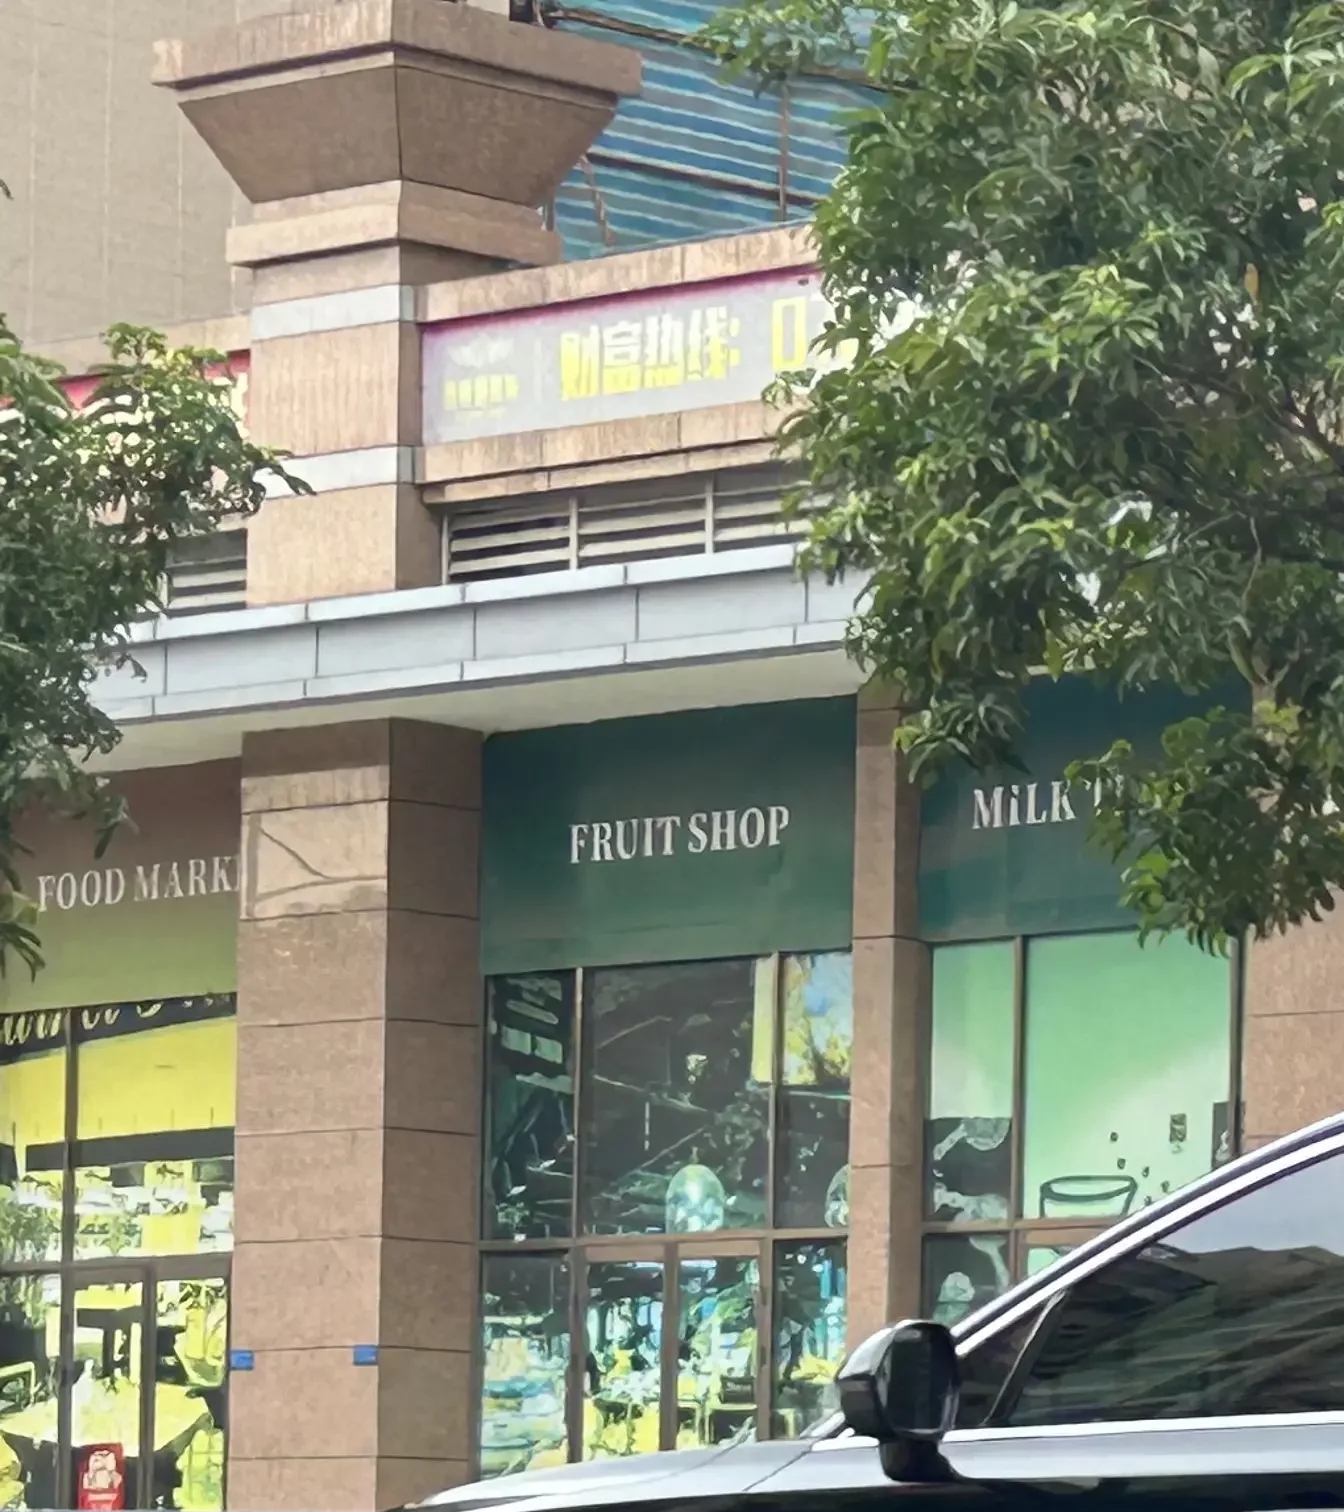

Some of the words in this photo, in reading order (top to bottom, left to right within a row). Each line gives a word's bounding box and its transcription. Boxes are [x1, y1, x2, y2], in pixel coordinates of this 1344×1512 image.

[568, 815, 681, 864] FRUIT
[687, 805, 790, 853] SHOP
[36, 867, 126, 912] FOOD
[133, 855, 241, 902] MARK
